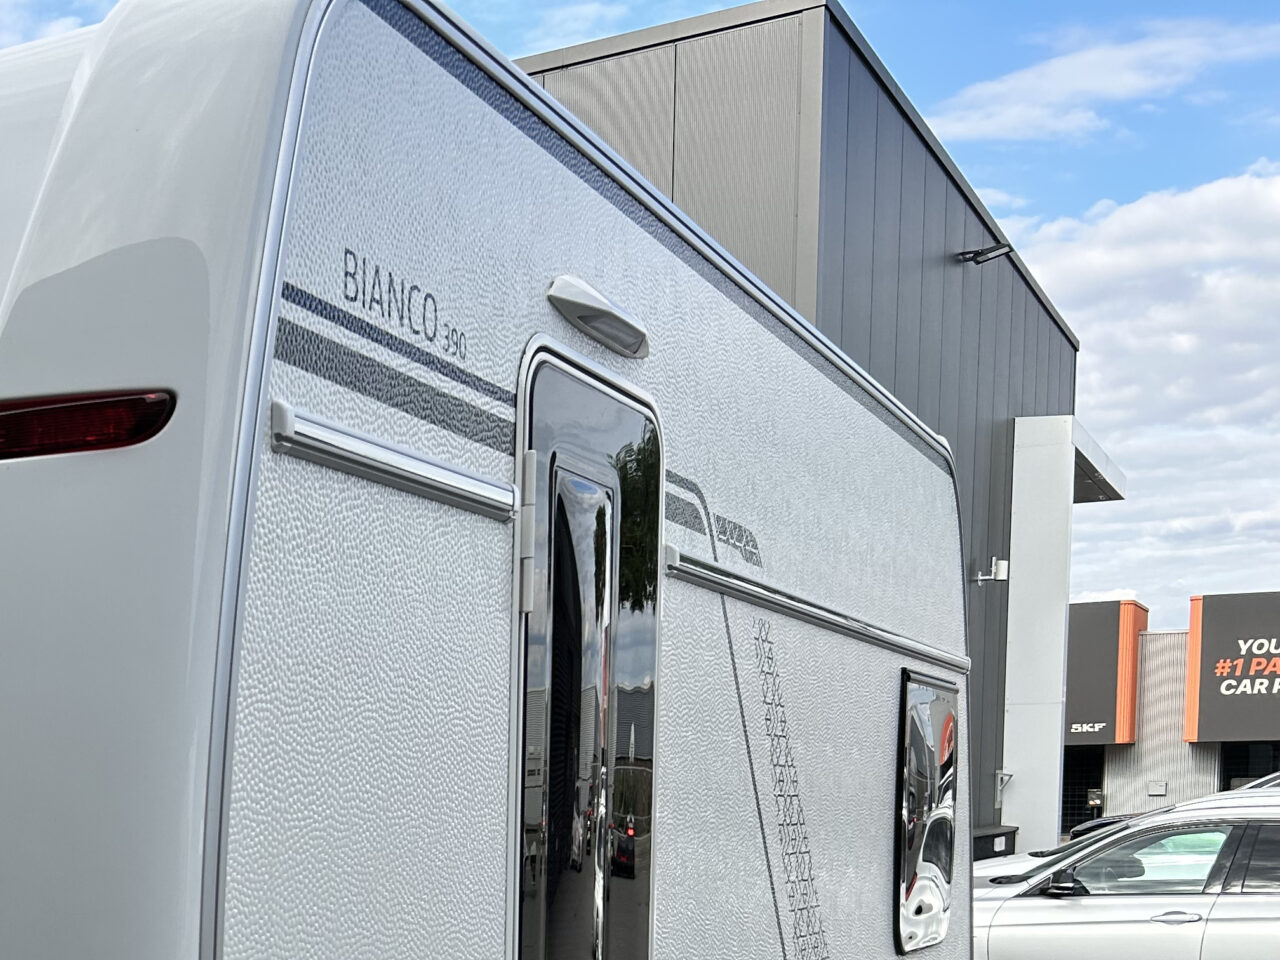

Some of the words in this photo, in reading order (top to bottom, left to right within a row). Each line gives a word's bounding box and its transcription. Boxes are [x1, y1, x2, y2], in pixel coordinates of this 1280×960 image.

[344, 248, 437, 342] BIANCO
[443, 323, 467, 360] 390
[1214, 658, 1244, 676] #1
[1220, 678, 1269, 695] CAR
[1070, 722, 1107, 733] SKF
